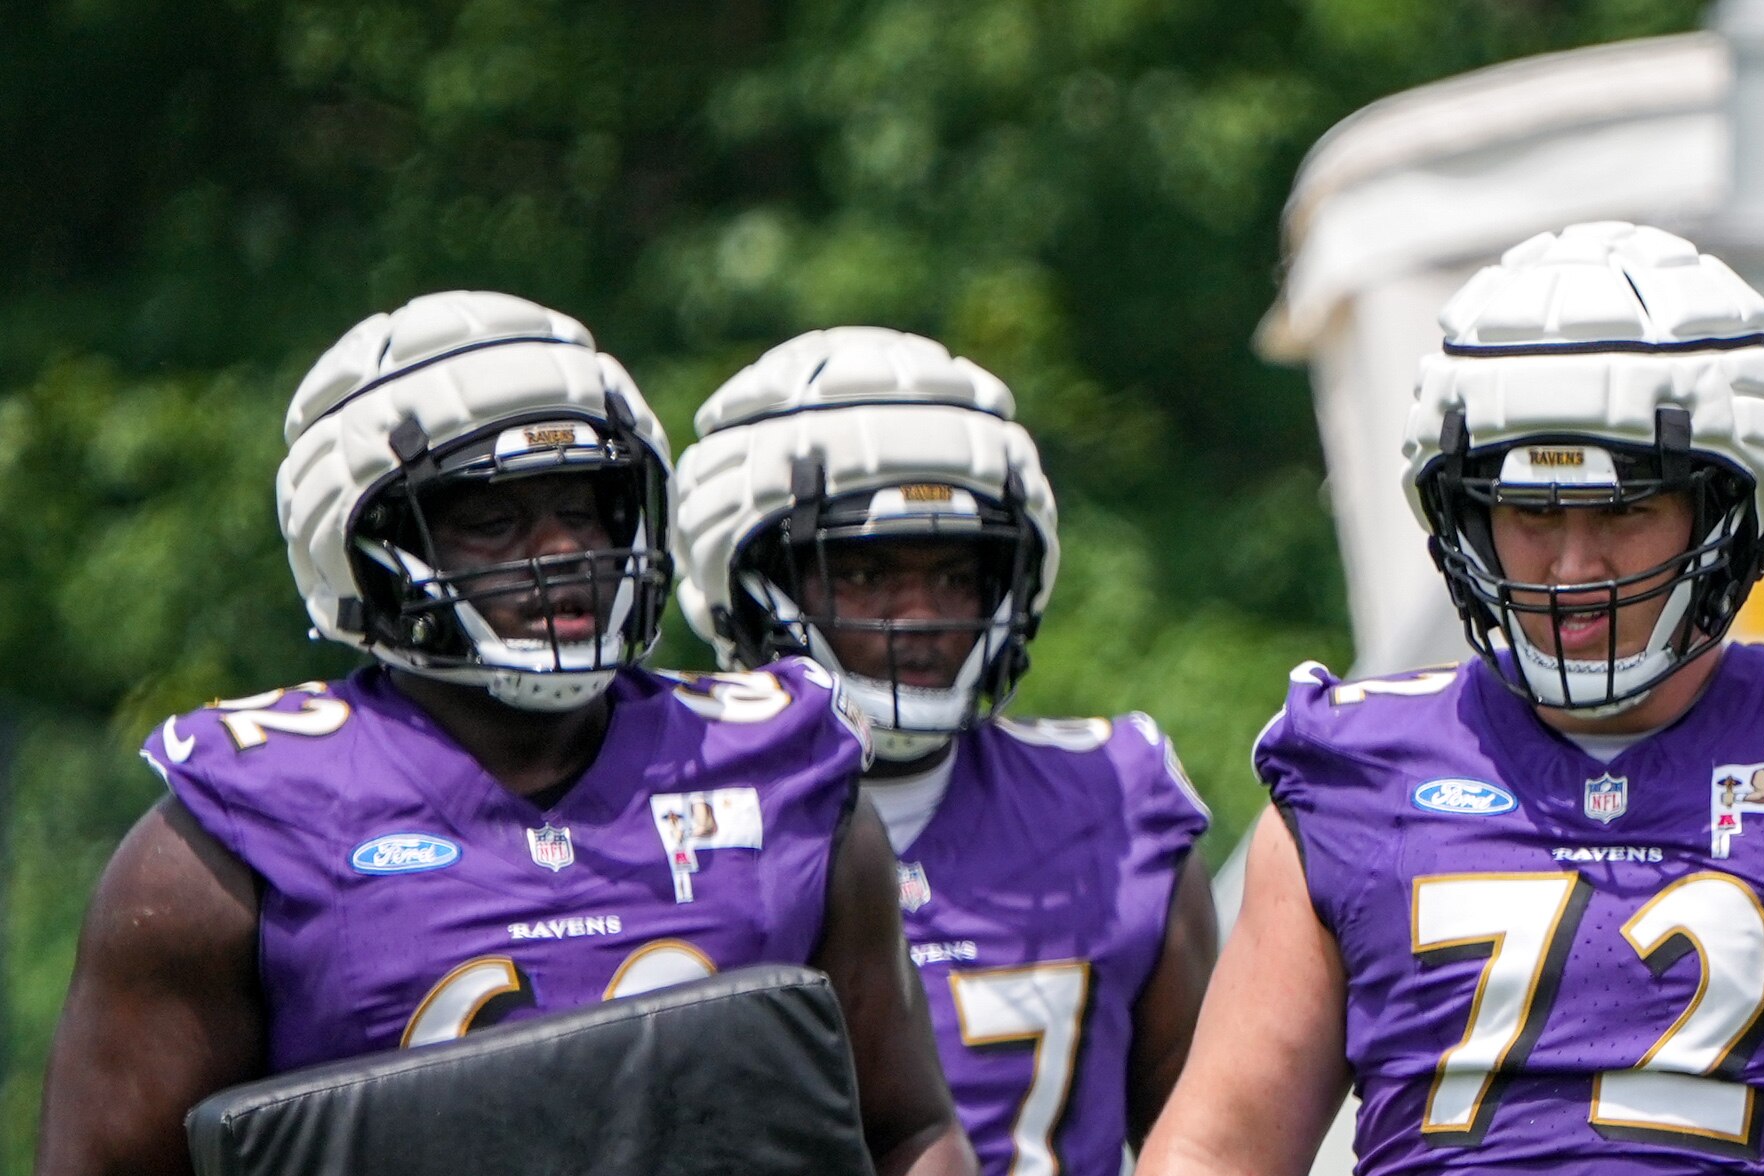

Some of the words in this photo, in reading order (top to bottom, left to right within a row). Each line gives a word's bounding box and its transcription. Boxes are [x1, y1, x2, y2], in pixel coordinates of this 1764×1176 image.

[1529, 450, 1585, 467] RAVENS
[1434, 780, 1496, 812] Ford
[1592, 793, 1622, 813] NFL
[372, 838, 437, 867] Ford
[536, 844, 567, 862] NFL
[1551, 846, 1663, 863] RAVENS
[506, 914, 623, 940] RAVENS
[910, 939, 978, 967] VENS
